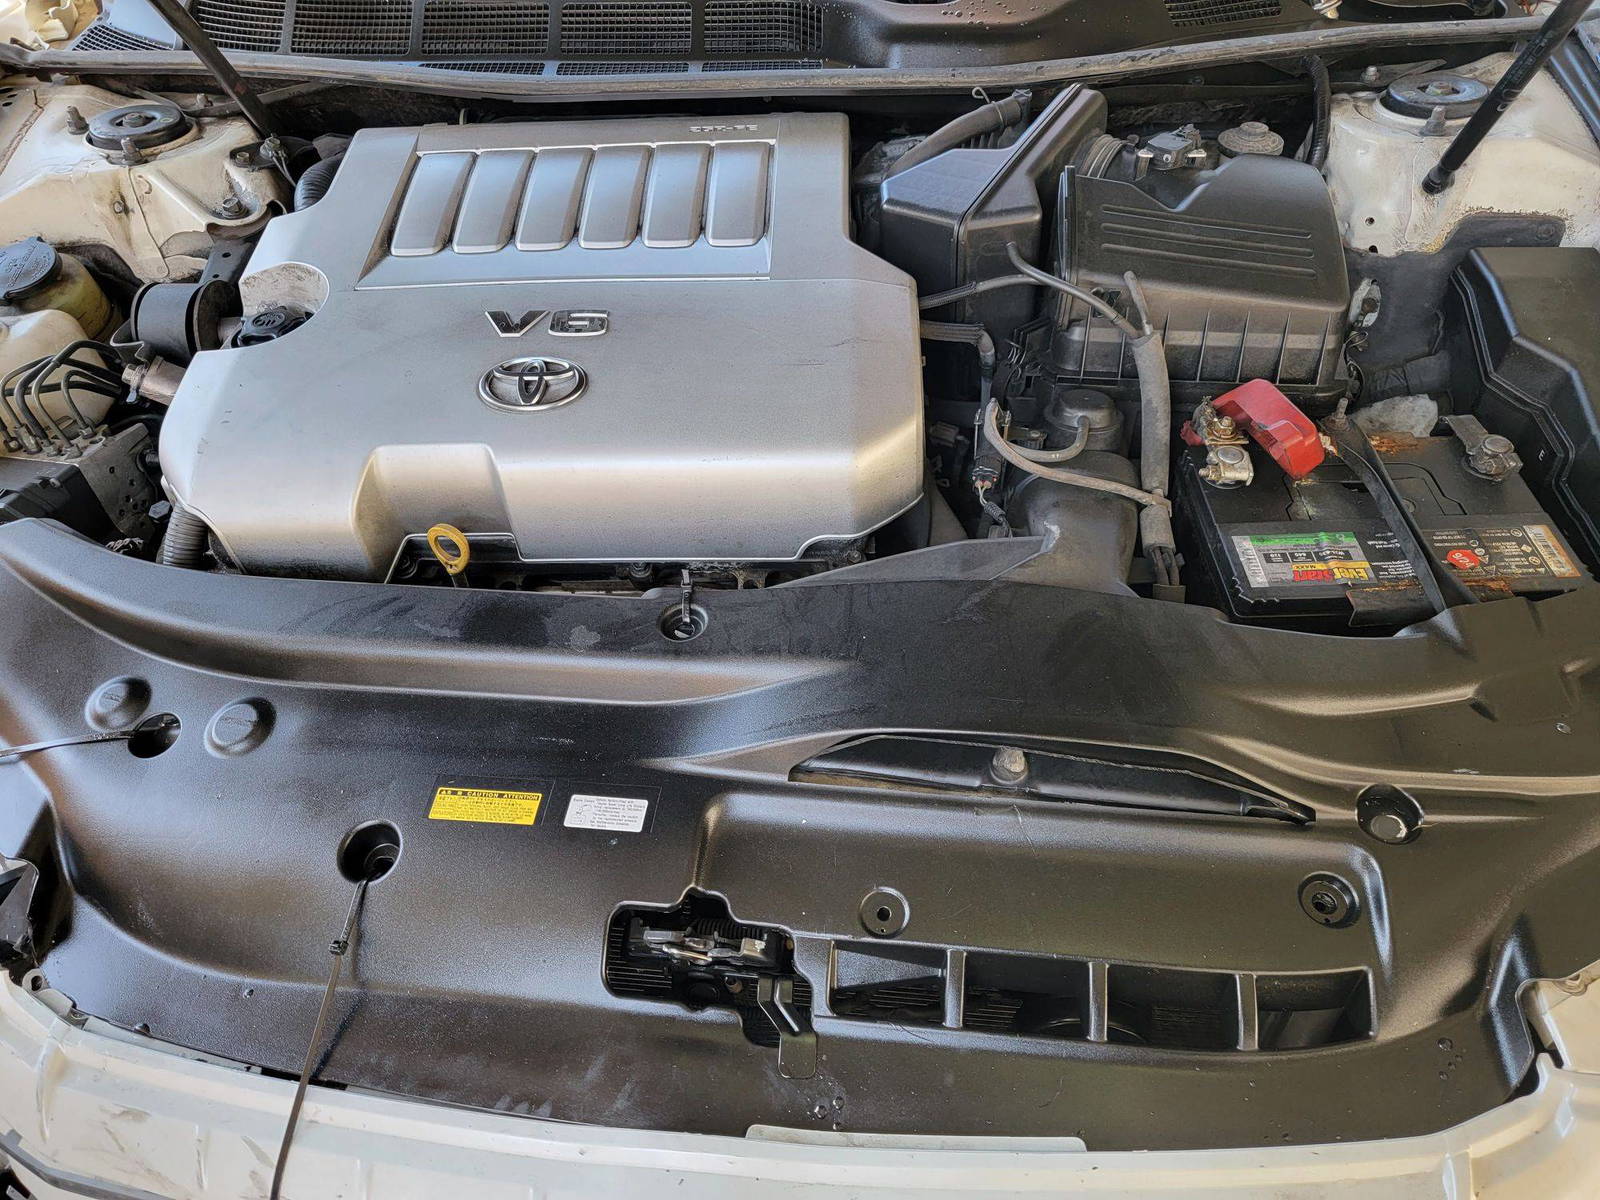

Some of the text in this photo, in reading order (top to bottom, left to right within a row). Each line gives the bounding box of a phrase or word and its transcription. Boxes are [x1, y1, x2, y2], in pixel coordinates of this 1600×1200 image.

[485, 310, 609, 337] V6
[1294, 568, 1369, 581] EverStart
[502, 792, 539, 800] ATTENTION
